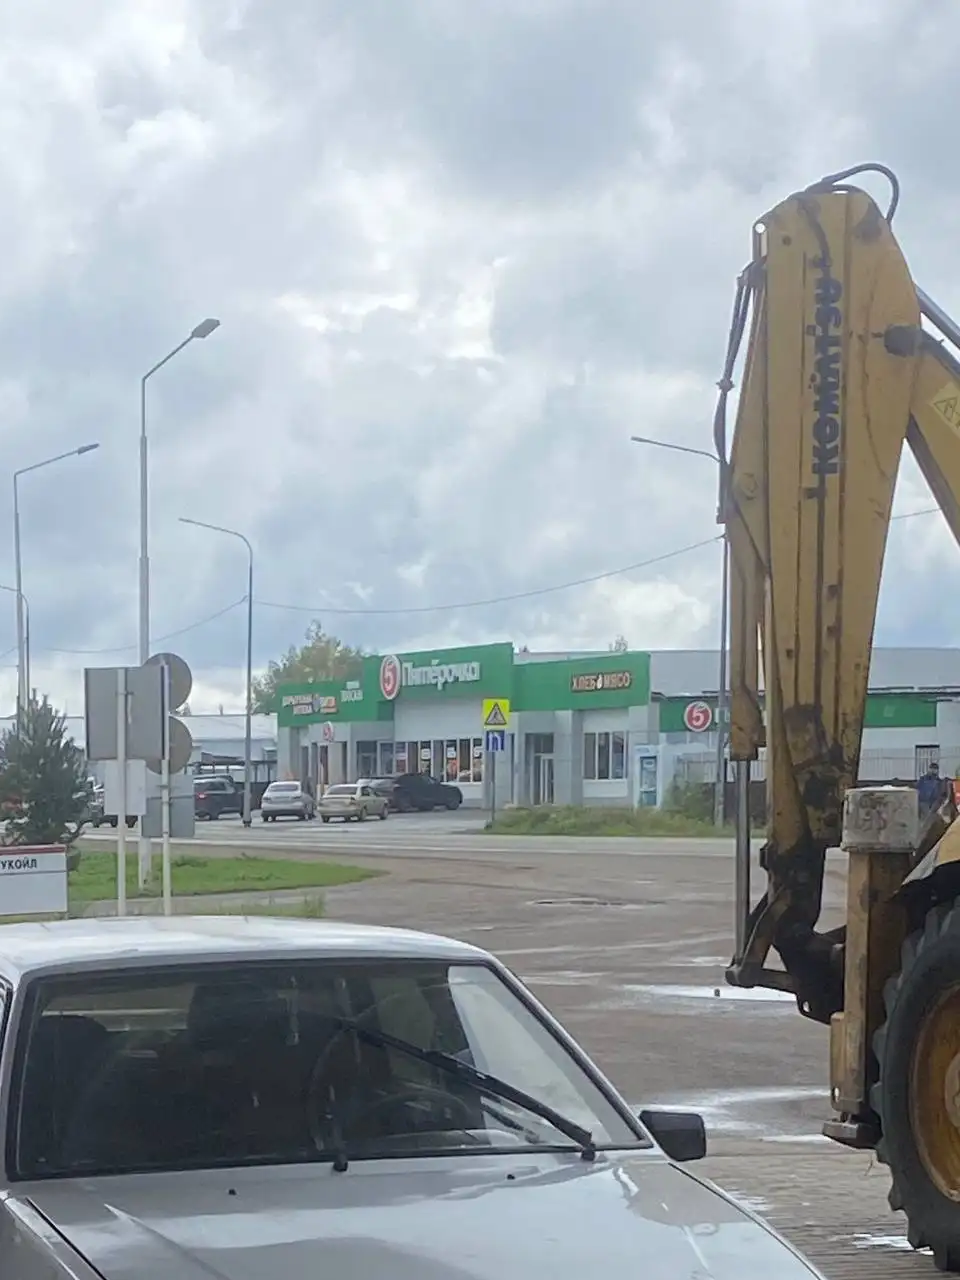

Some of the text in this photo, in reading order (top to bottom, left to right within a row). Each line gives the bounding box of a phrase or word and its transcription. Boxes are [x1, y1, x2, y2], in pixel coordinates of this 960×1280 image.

[812, 277, 841, 474] KOMATSU
[572, 672, 630, 690] ХЛЕБ МЯСО
